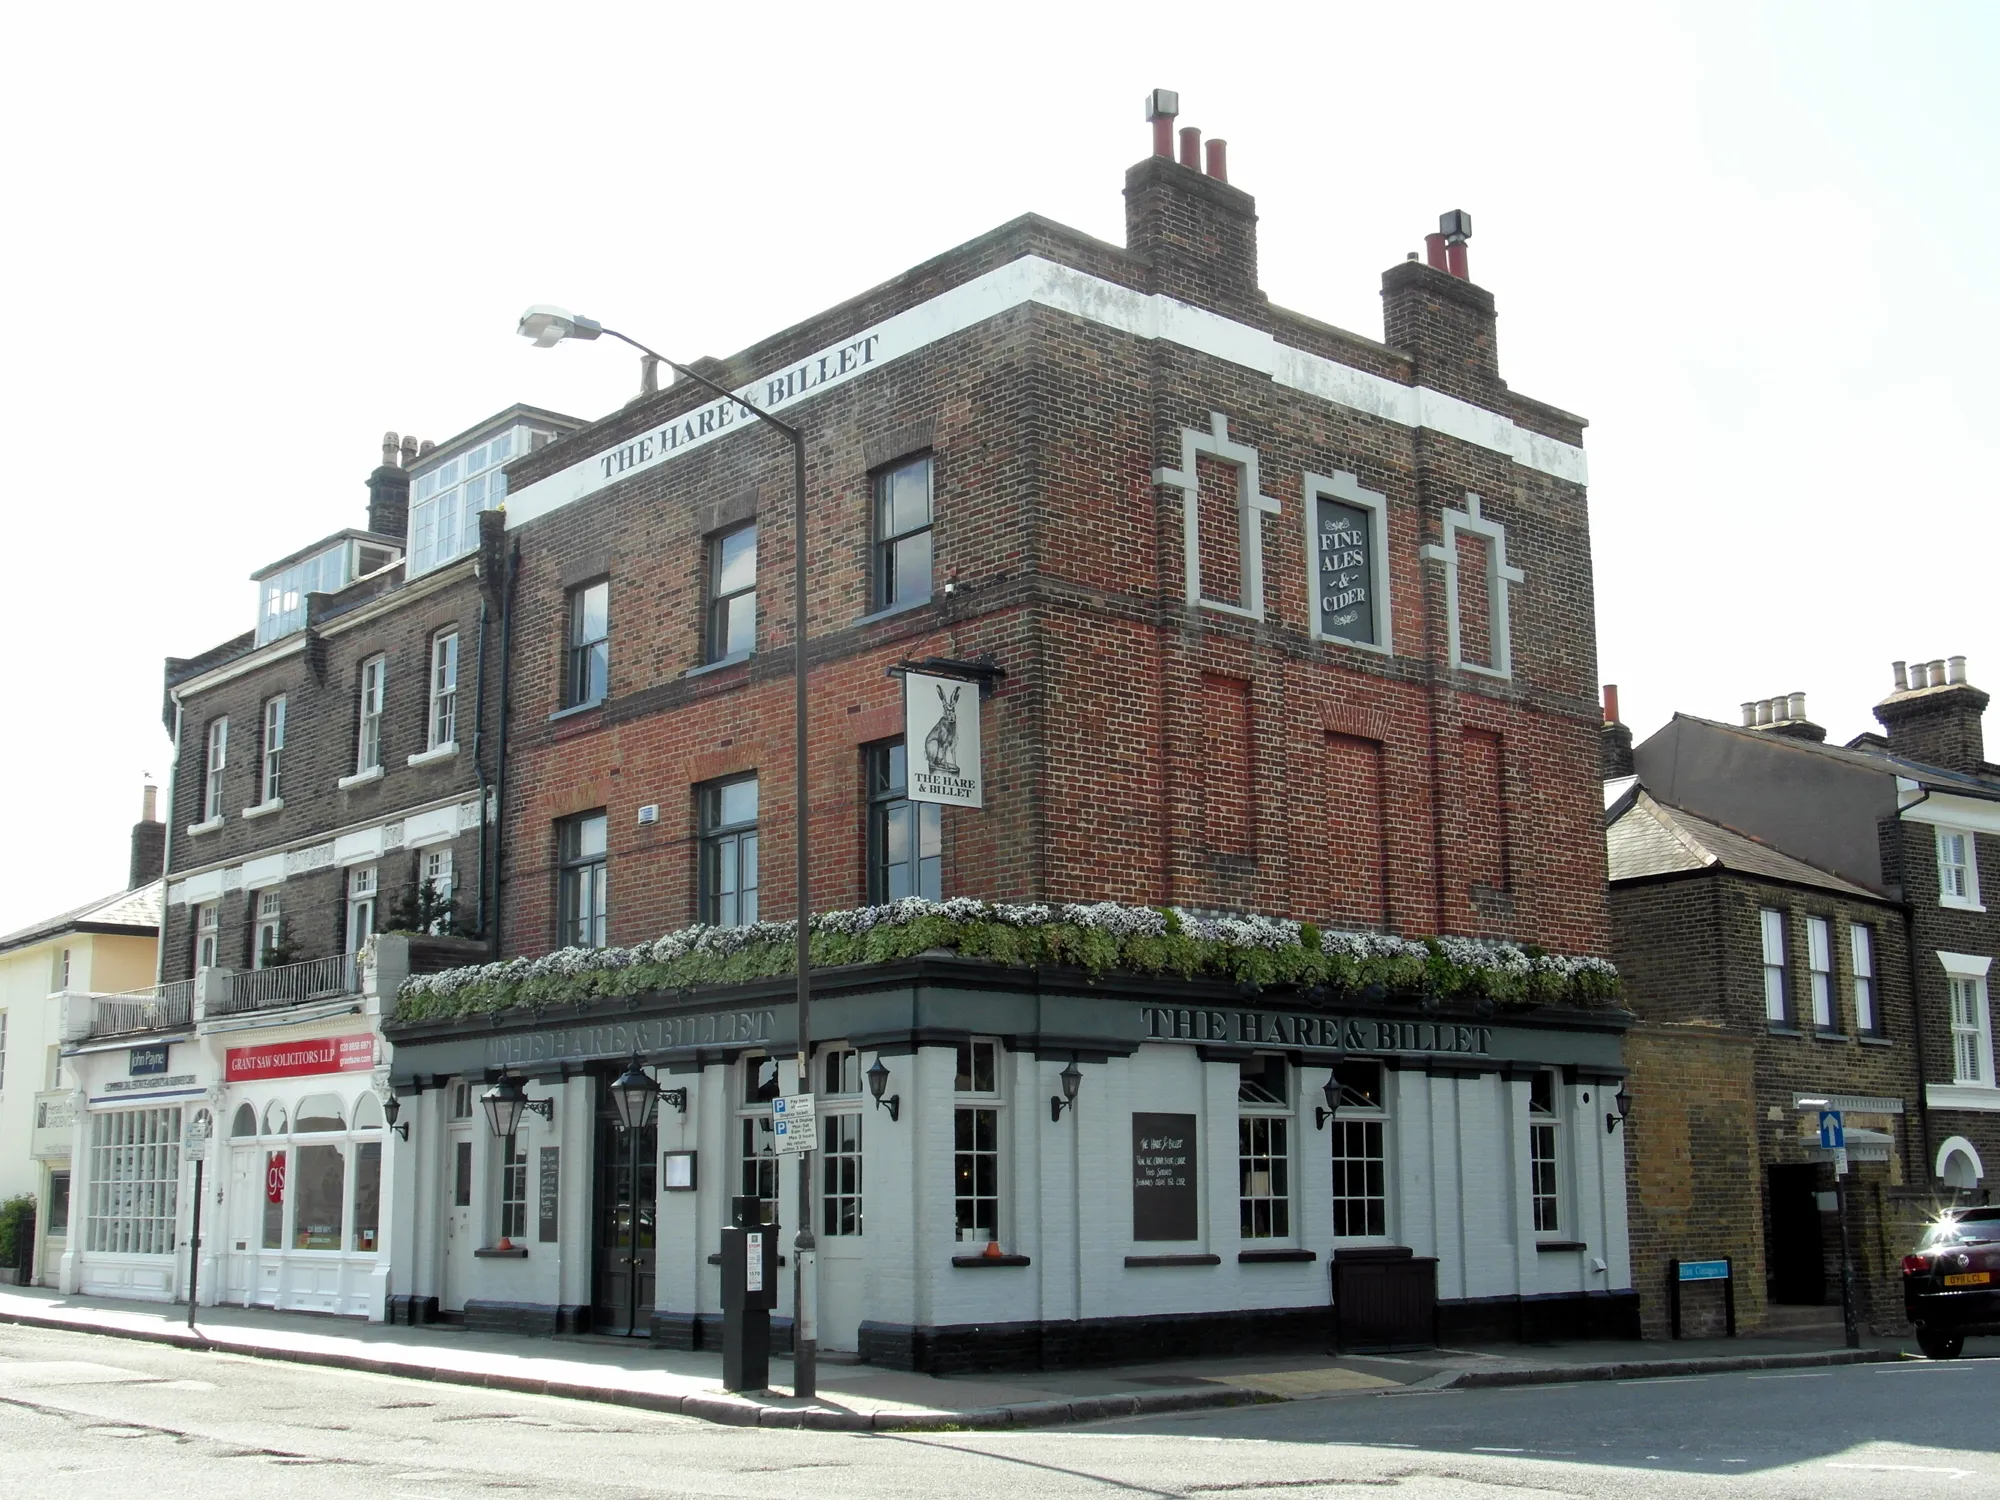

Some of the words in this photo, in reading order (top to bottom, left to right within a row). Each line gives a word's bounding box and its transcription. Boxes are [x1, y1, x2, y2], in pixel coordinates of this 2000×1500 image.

[601, 437, 653, 478] THE
[658, 400, 733, 454] HARE
[740, 391, 759, 419] &
[766, 334, 879, 407] BILLET
[1320, 531, 1362, 550] FINE
[1322, 549, 1363, 571] ALES
[1323, 588, 1365, 612] CIDER
[915, 773, 940, 784] THE
[943, 777, 975, 789] HARE
[919, 784, 926, 792] &
[930, 785, 972, 798] BILLET
[491, 1033, 545, 1066] THE
[549, 1026, 627, 1061] HARE
[630, 1023, 650, 1053] &
[656, 1010, 775, 1051] BILLET
[1141, 1007, 1227, 1042] THE
[1235, 1012, 1339, 1049] HARE
[1344, 1020, 1367, 1051] &
[1373, 1021, 1492, 1055] BILLET
[131, 1051, 145, 1072] John
[145, 1050, 164, 1071] Payne
[231, 1057, 256, 1071] GRANT
[256, 1055, 272, 1069] SAW
[273, 1050, 318, 1067] SOLICITORS
[319, 1048, 335, 1062] LLP
